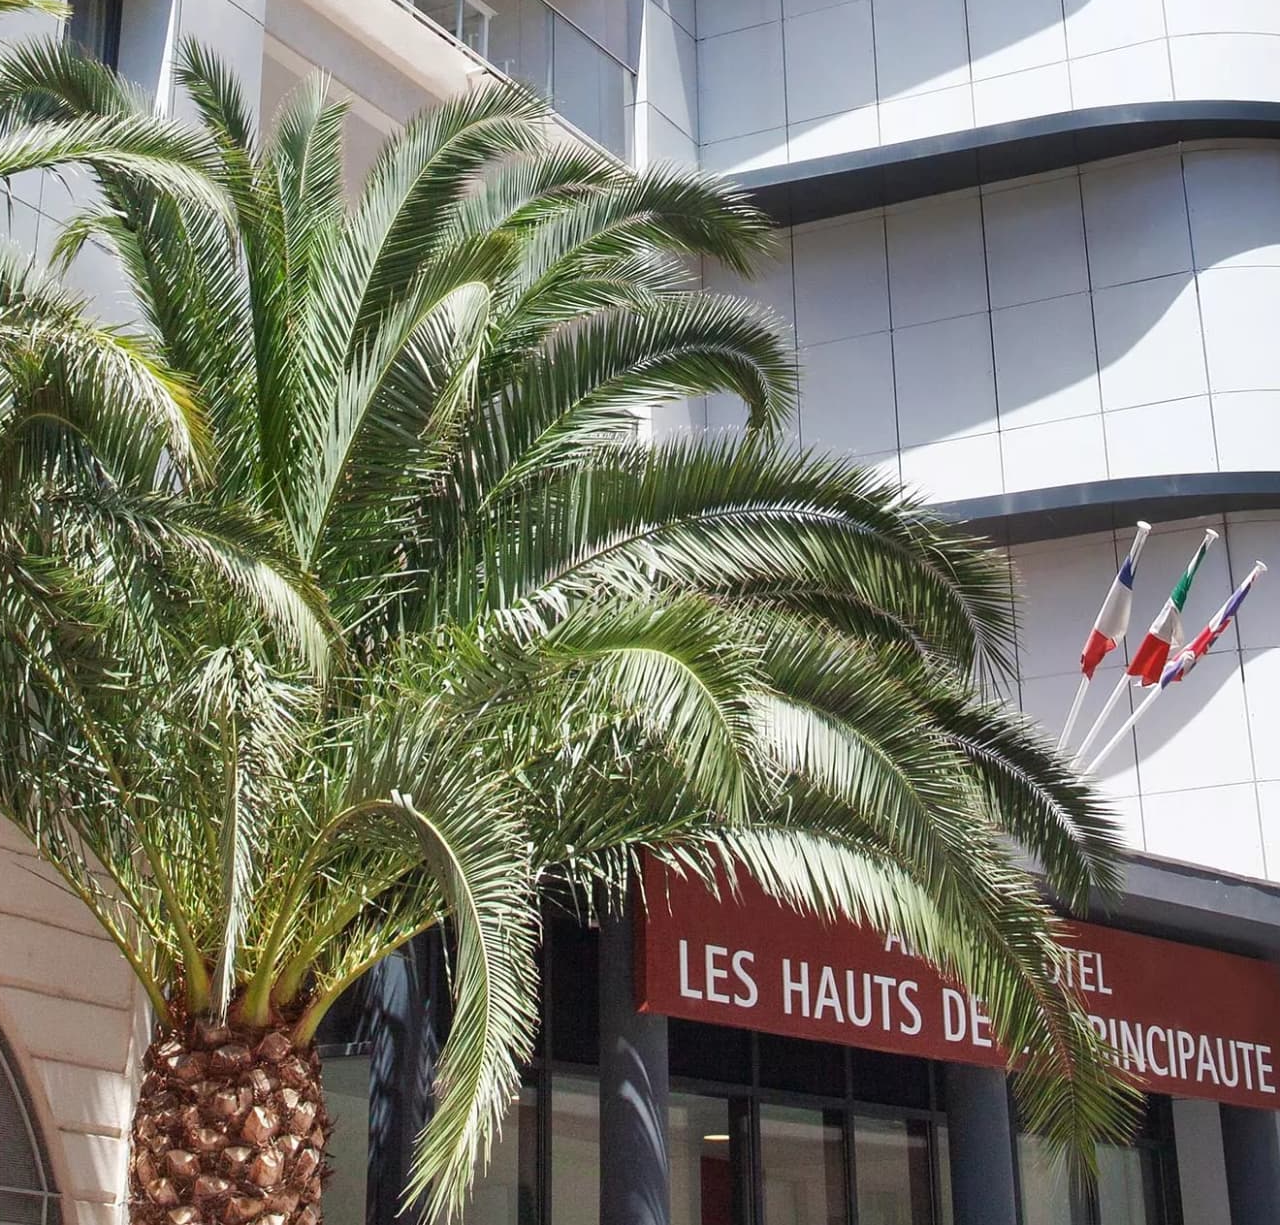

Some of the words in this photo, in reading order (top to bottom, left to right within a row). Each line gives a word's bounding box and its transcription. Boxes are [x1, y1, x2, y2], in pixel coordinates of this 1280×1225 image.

[678, 938, 759, 1009] LES
[781, 958, 923, 1036] HAUTS
[941, 986, 993, 1048] DE
[1070, 1011, 1276, 1094] RINCIPAUTE
